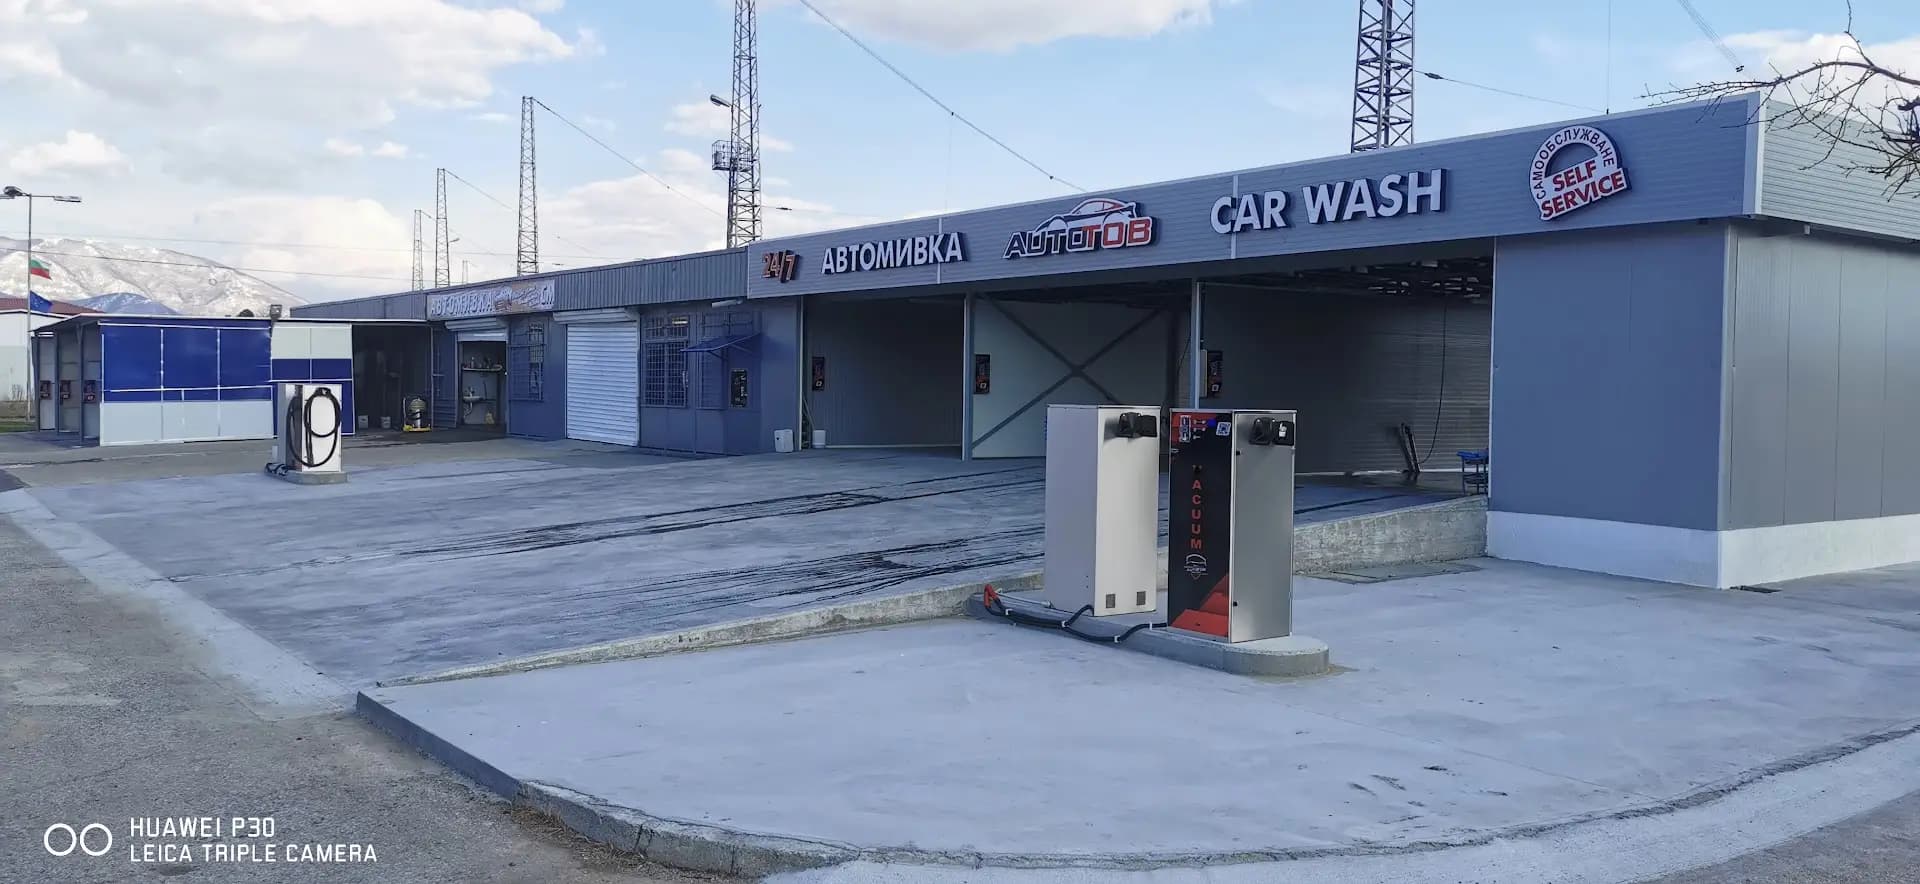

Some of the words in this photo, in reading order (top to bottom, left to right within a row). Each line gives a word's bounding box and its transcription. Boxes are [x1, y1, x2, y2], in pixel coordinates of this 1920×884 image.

[1532, 127, 1615, 200] САМООБСЛУЖВАНЕ
[1552, 159, 1597, 192] SELF
[1210, 189, 1288, 235] CAR
[1302, 168, 1446, 225] WASH
[1540, 170, 1625, 219] SERVICE
[761, 250, 797, 282] 24/7
[821, 231, 964, 275] АВТОМИВКА
